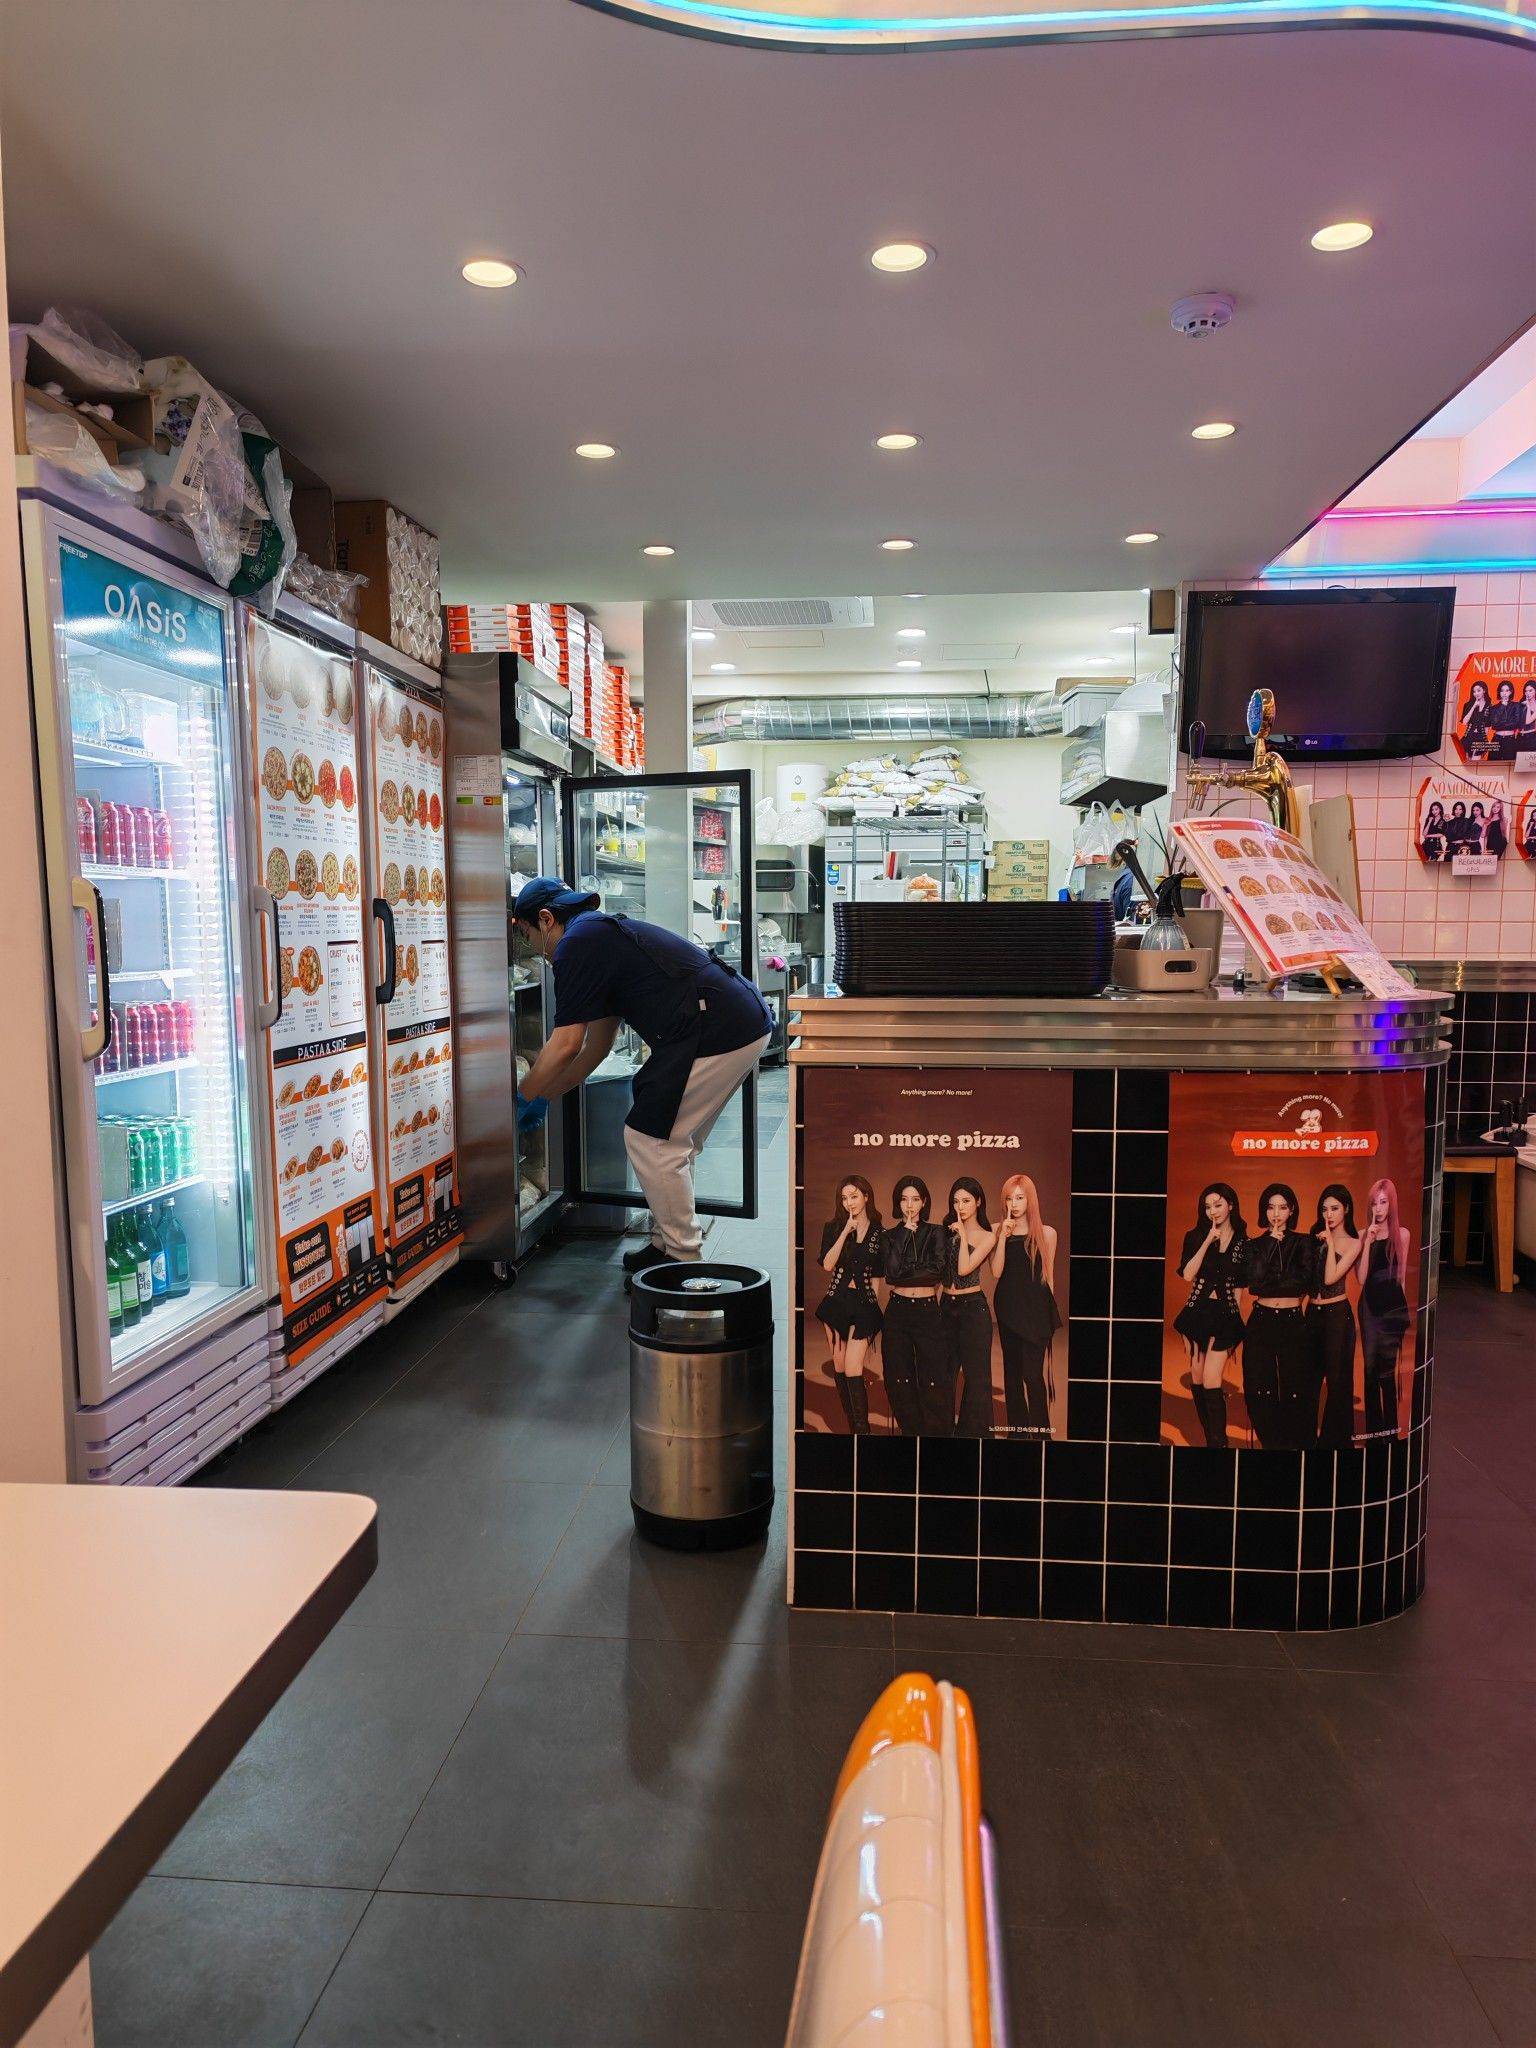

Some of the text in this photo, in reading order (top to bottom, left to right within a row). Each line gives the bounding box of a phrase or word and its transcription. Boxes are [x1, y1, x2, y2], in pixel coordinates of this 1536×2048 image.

[1473, 656, 1491, 673] NO
[1493, 656, 1527, 673] MORE
[1448, 781, 1474, 795] MORE
[1478, 781, 1505, 795] PIZZA
[405, 1026, 420, 1038] PASTA
[424, 1022, 436, 1033] SIDE
[298, 1038, 347, 1060] PASTA & SIDE
[901, 1089, 926, 1097] Anything
[1278, 1096, 1303, 1118] Anything
[1323, 1096, 1332, 1104] No
[853, 1131, 1021, 1150] no more pizza
[1242, 1136, 1369, 1153] no more pizza
[292, 1302, 333, 1338] SIZE GUIDE
